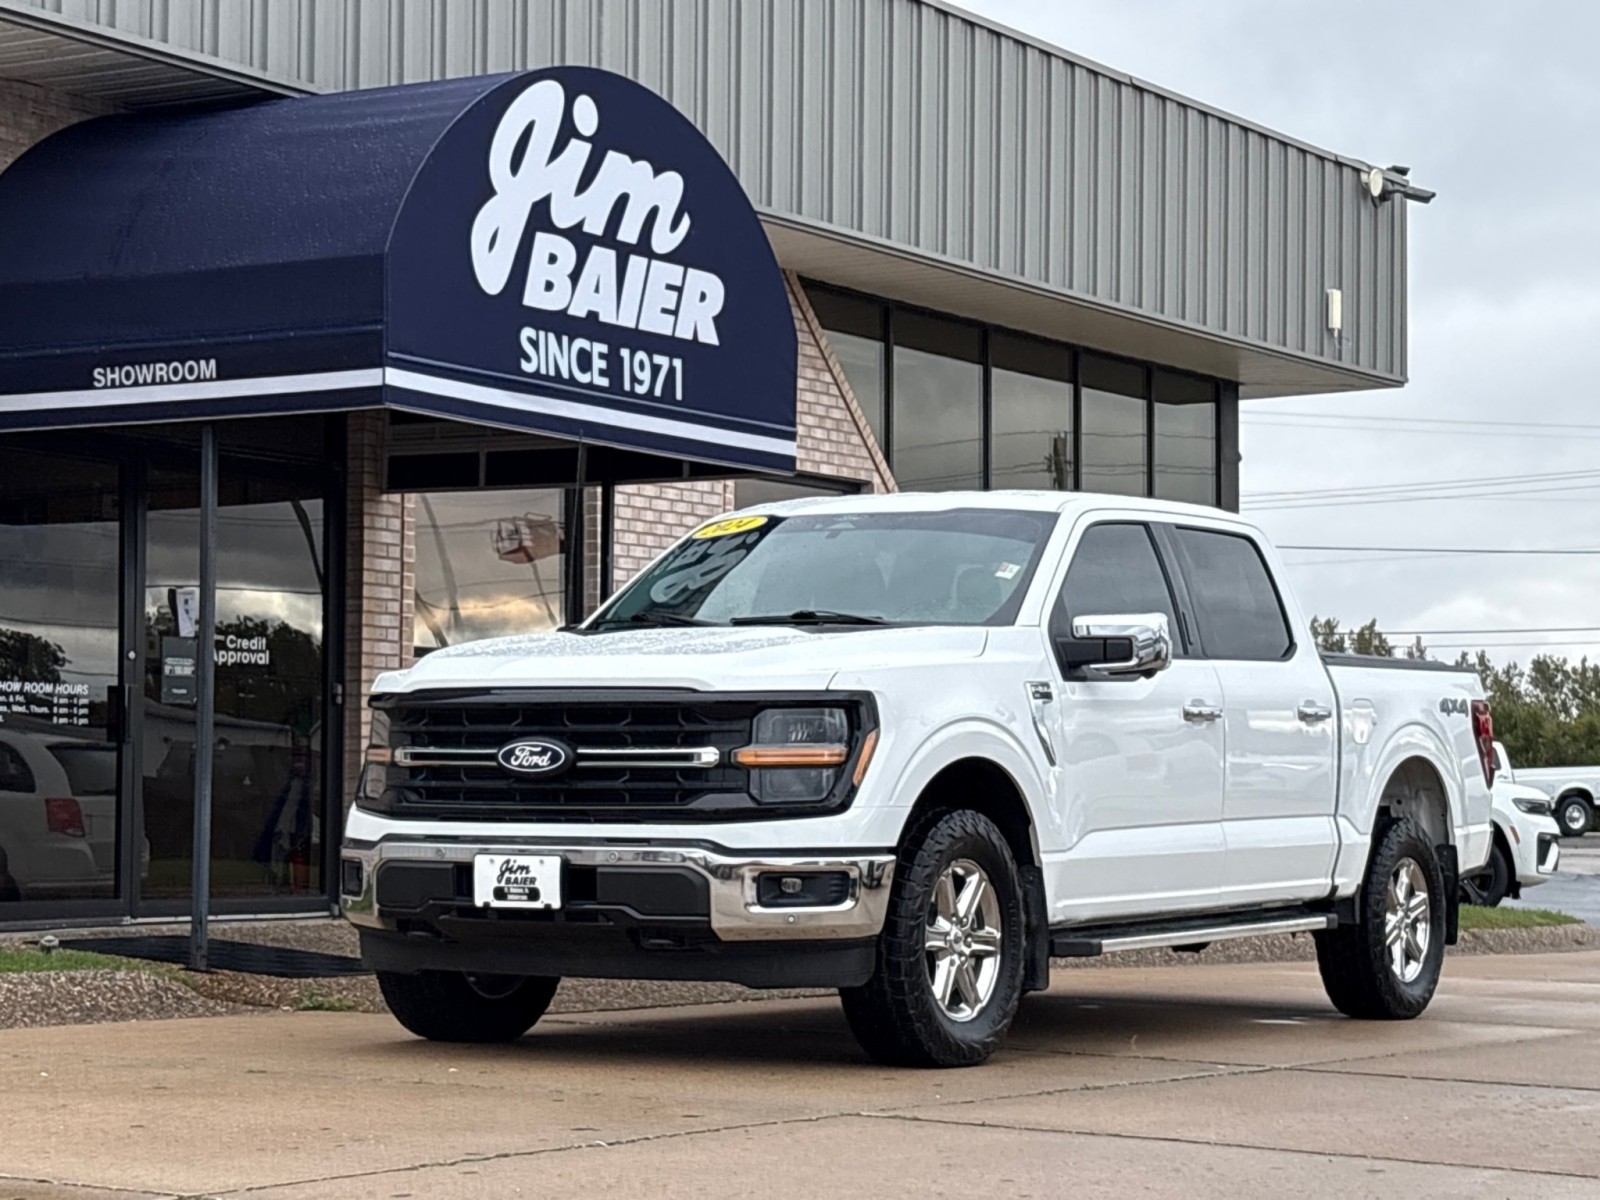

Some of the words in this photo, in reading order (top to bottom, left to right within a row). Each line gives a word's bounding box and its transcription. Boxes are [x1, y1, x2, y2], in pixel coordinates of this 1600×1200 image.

[471, 79, 691, 296] Jim
[522, 231, 725, 346] BAIER
[93, 358, 217, 388] SHOWROOM
[519, 326, 610, 388] SINCE
[620, 347, 683, 401] 1971
[226, 635, 267, 650] Credit
[0, 681, 22, 693] HOW
[23, 682, 54, 694] ROOM
[55, 683, 89, 696] HOURS
[511, 745, 552, 766] Ford
[496, 858, 531, 885] Jim
[504, 876, 538, 886] BAIER
